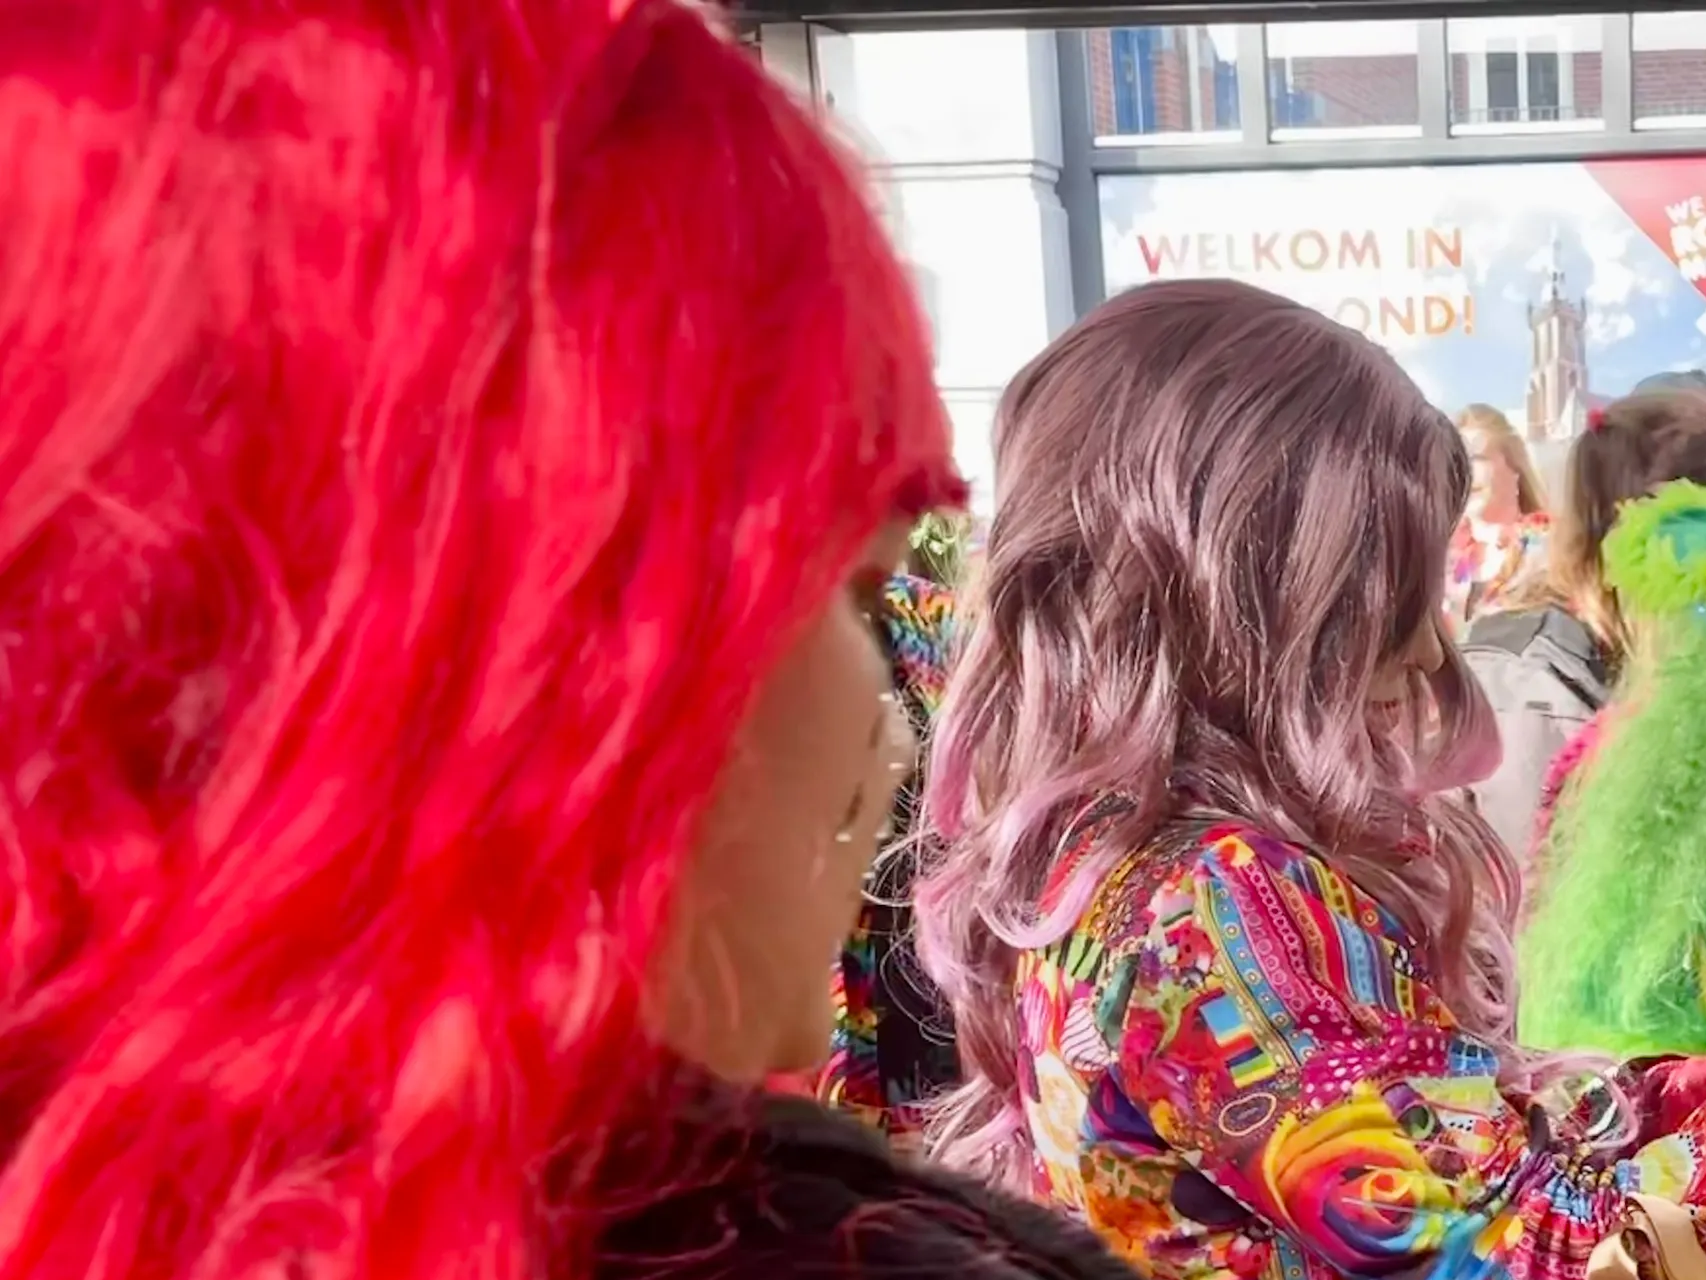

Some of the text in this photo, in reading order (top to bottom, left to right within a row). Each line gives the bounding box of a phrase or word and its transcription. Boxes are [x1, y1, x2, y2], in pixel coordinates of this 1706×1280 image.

[1664, 196, 1704, 223] WE
[1137, 227, 1463, 274] WELKOM IN
